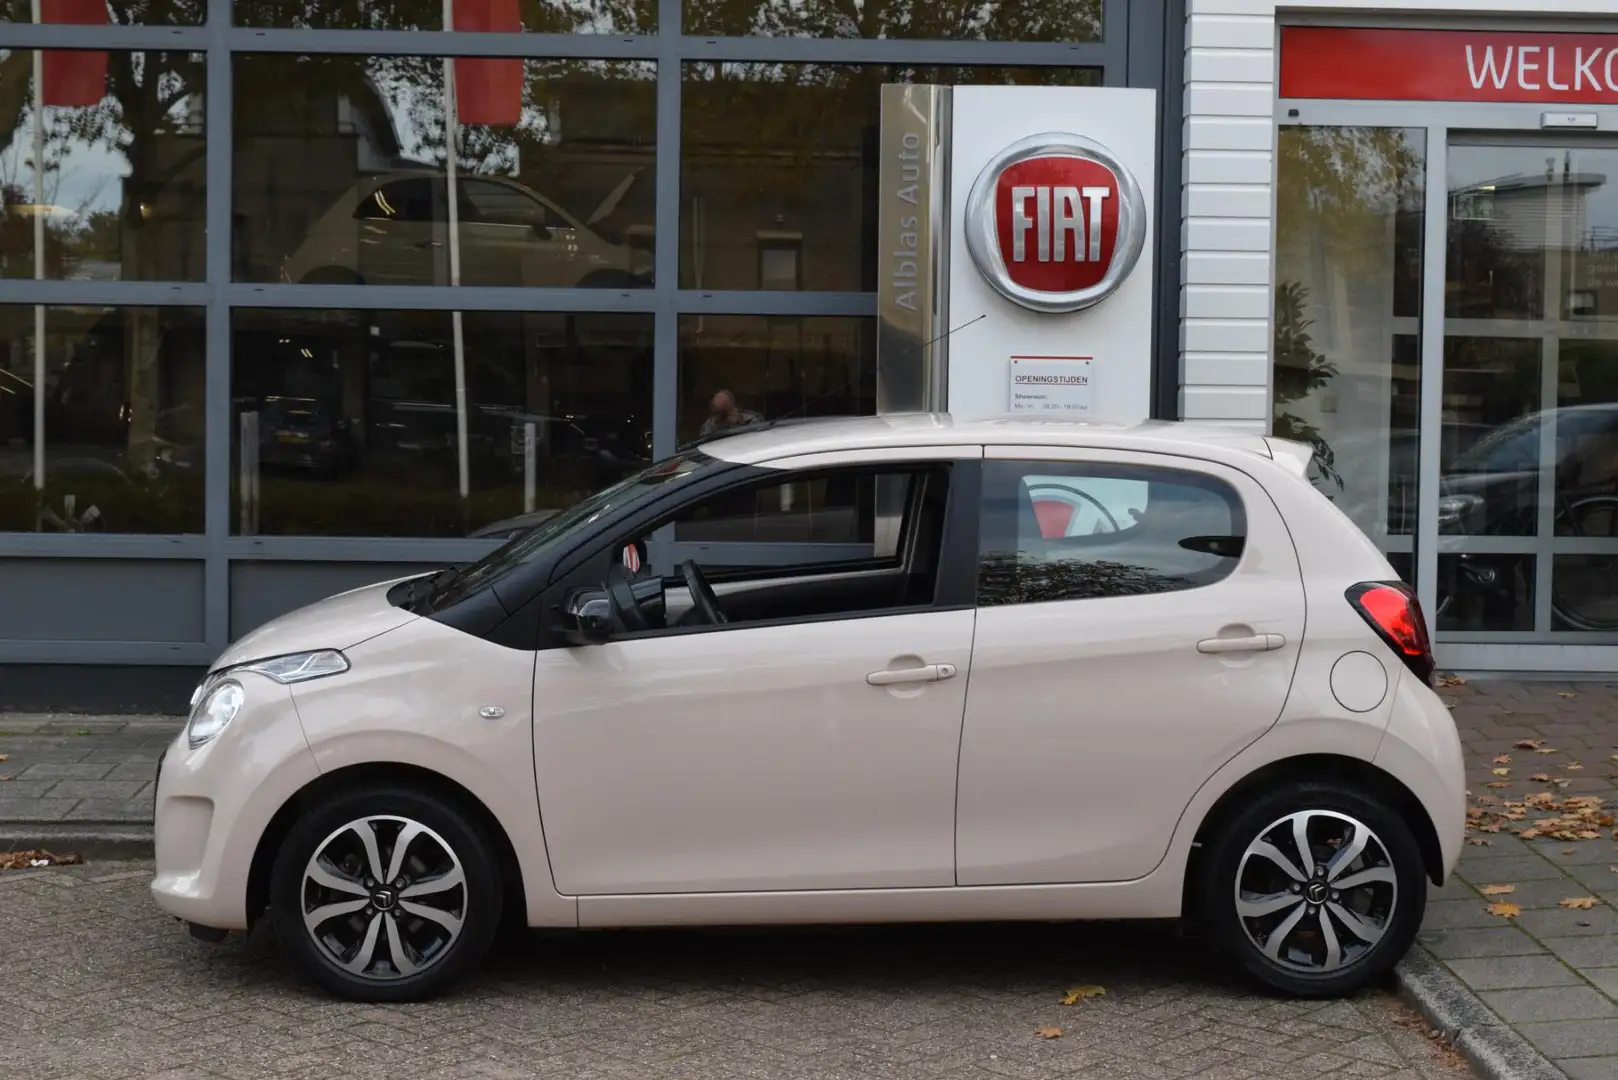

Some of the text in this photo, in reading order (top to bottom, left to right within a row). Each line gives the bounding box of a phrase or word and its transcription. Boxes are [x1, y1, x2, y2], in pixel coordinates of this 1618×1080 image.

[893, 132, 921, 311] Alblas Auto
[1012, 186, 1110, 263] FIAT
[1015, 375, 1088, 384] OPENINGSTIJDEN
